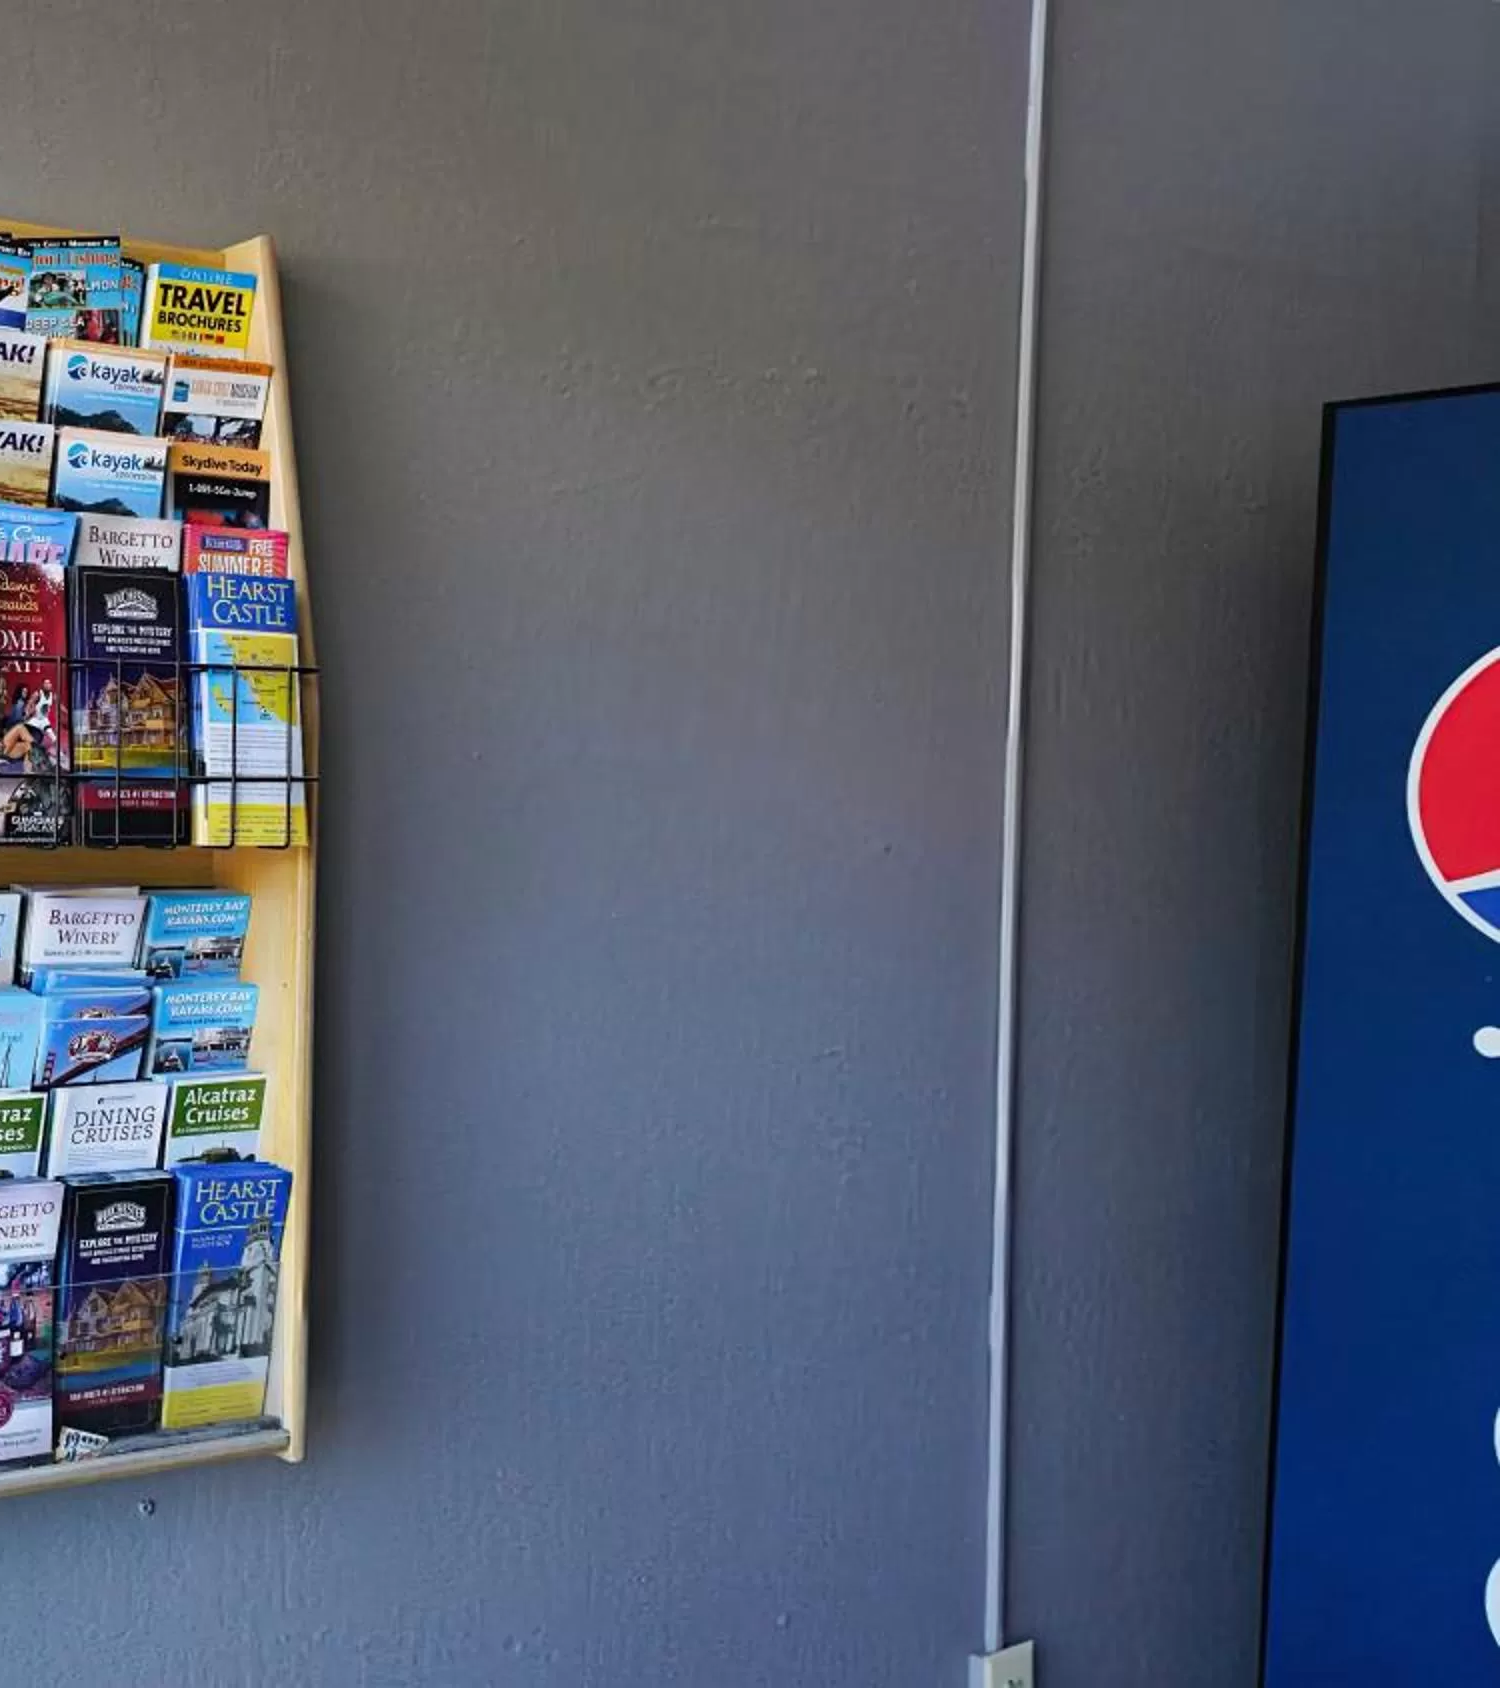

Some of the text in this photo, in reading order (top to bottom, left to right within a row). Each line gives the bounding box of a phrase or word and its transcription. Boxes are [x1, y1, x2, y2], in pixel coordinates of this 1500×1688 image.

[180, 269, 233, 285] ONLINE
[159, 284, 246, 317] TRAVEL
[158, 312, 241, 334] BROCHURES
[92, 361, 140, 384] kayak
[91, 450, 141, 473] kayak
[182, 454, 262, 477] Skydive Today
[89, 525, 173, 548] BARGETTO
[100, 548, 161, 568] WINERY
[199, 553, 261, 576] SUMMER
[207, 575, 291, 603] HEARST
[212, 600, 286, 625] CASTLE
[49, 909, 135, 927] BARGETTO
[164, 900, 246, 915] MONTEREY BAY
[57, 928, 121, 945] WINERY
[166, 991, 253, 1005] MONTEREY BAY
[184, 1086, 256, 1107] Alcatraz
[74, 1105, 156, 1129] DINING
[185, 1105, 249, 1124] Cruises
[71, 1124, 154, 1145] CRUISES
[197, 1179, 282, 1203] HEARST
[201, 1200, 277, 1226] CASTLE
